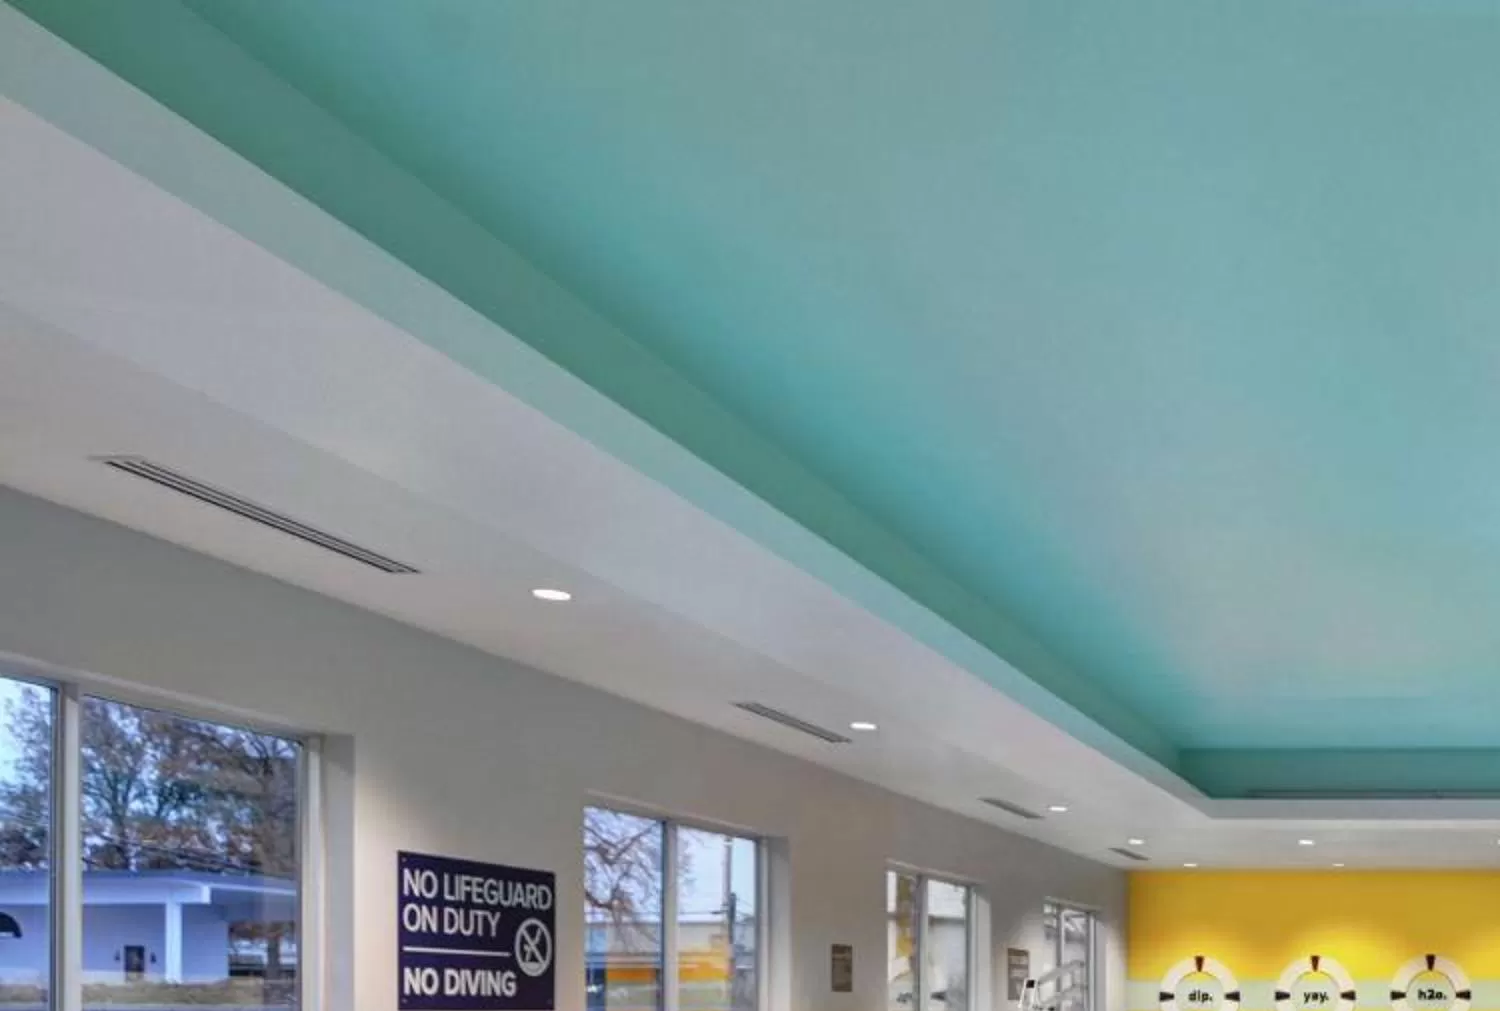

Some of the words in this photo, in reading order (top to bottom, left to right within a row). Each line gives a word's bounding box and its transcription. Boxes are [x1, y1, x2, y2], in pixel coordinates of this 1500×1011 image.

[403, 868, 438, 899] NO
[443, 873, 552, 910] LIFEGUARD
[403, 903, 437, 934] ON
[443, 907, 501, 938] DUTY
[403, 967, 439, 996] NO
[443, 968, 517, 997] DIVING
